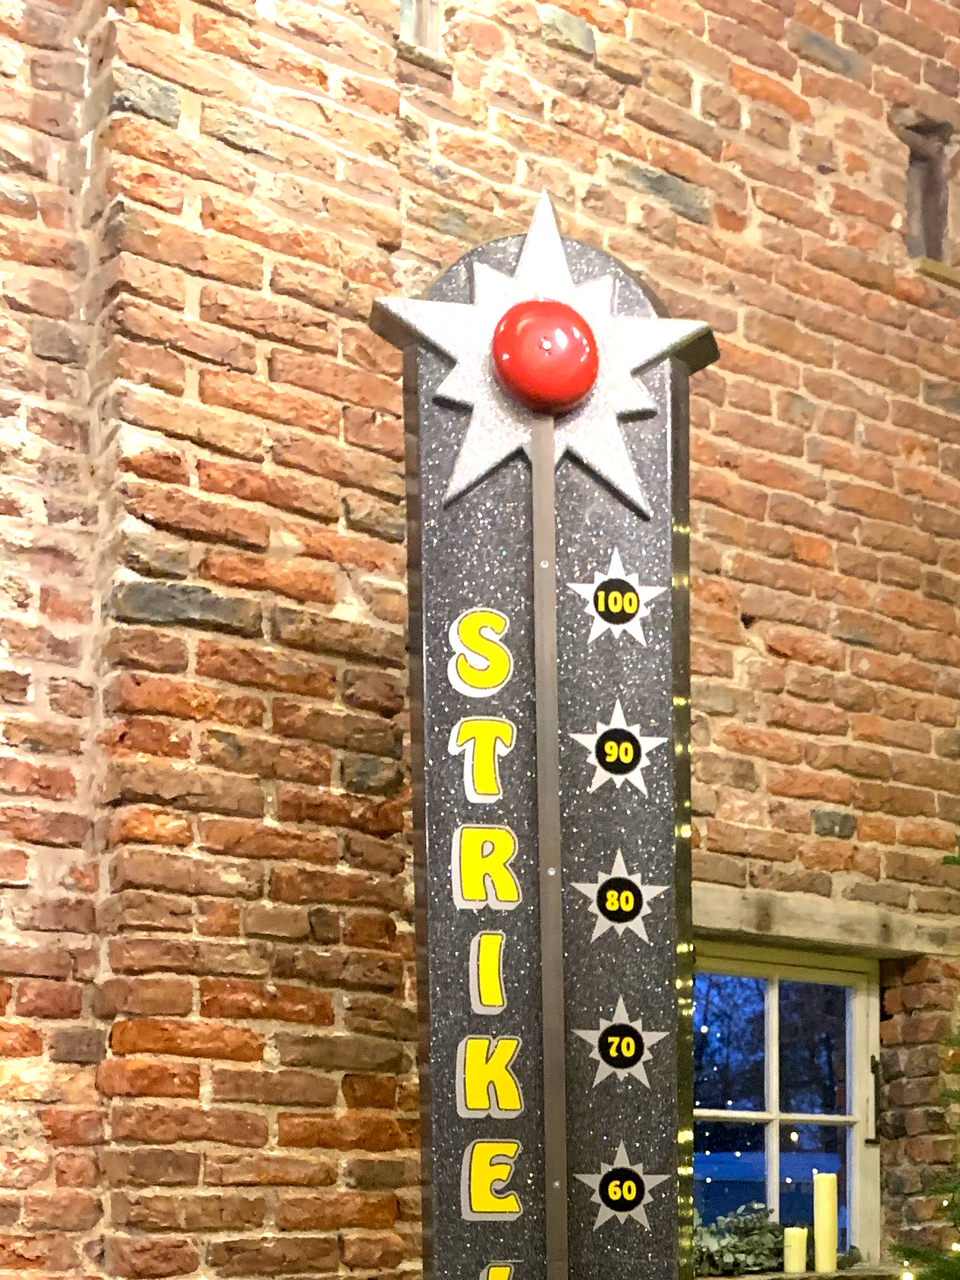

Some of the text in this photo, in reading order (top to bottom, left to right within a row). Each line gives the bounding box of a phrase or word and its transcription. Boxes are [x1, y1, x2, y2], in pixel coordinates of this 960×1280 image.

[596, 589, 639, 614] 100
[603, 740, 634, 764] 90
[604, 889, 635, 912] 80
[448, 607, 524, 1221] STRIKE
[607, 1036, 636, 1058] 70
[607, 1180, 637, 1201] 60
